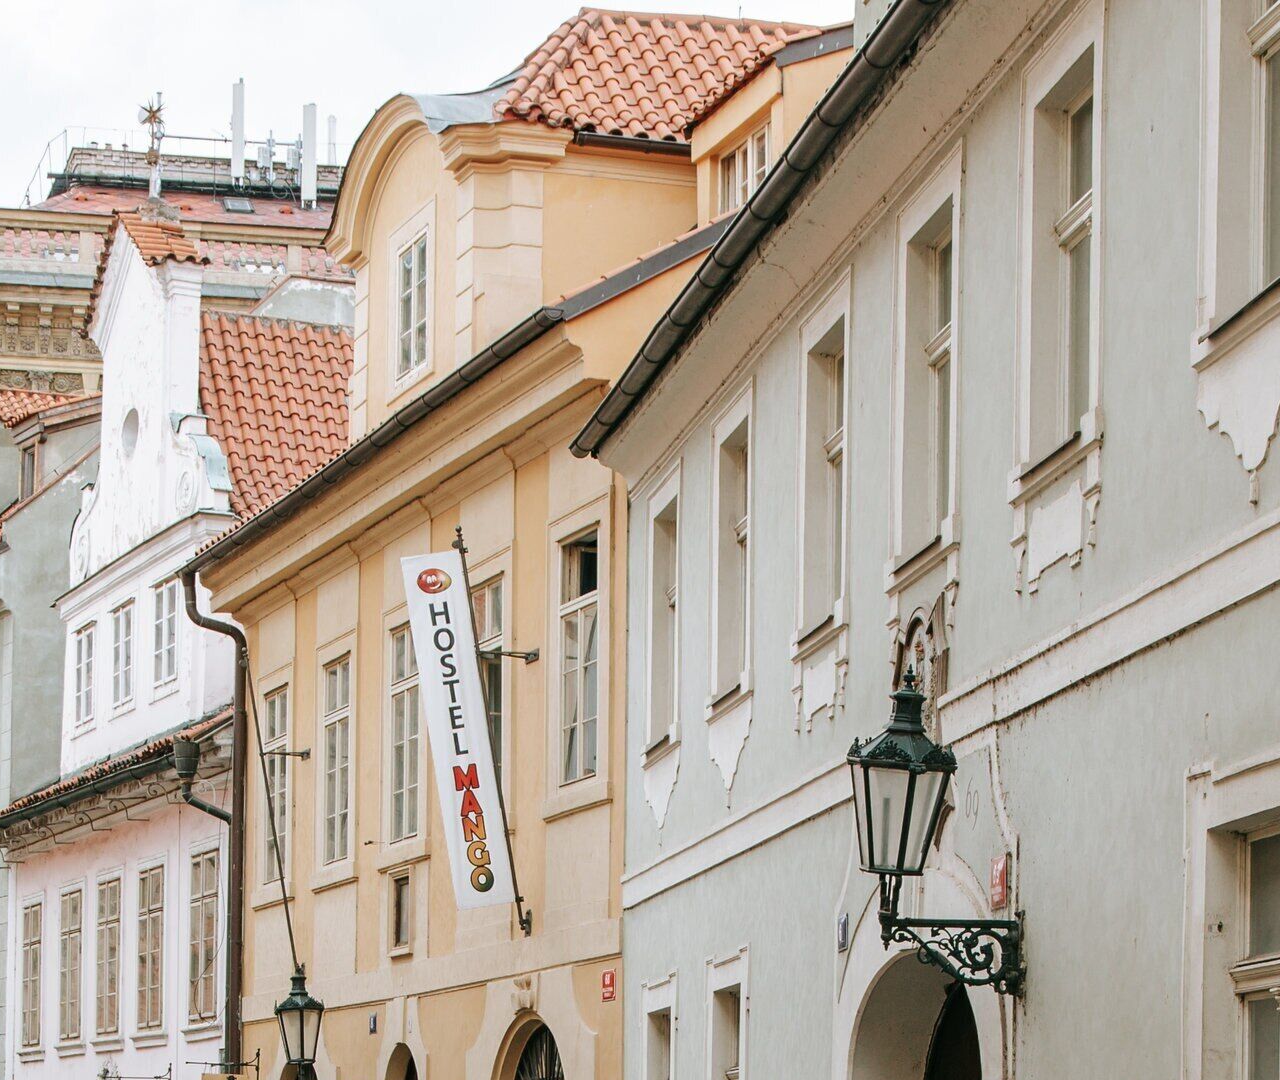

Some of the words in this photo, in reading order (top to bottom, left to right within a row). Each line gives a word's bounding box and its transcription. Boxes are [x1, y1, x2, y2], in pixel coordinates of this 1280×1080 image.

[429, 601, 468, 756] HOSTEL
[452, 763, 495, 893] MANGO
[965, 776, 979, 831] 69
